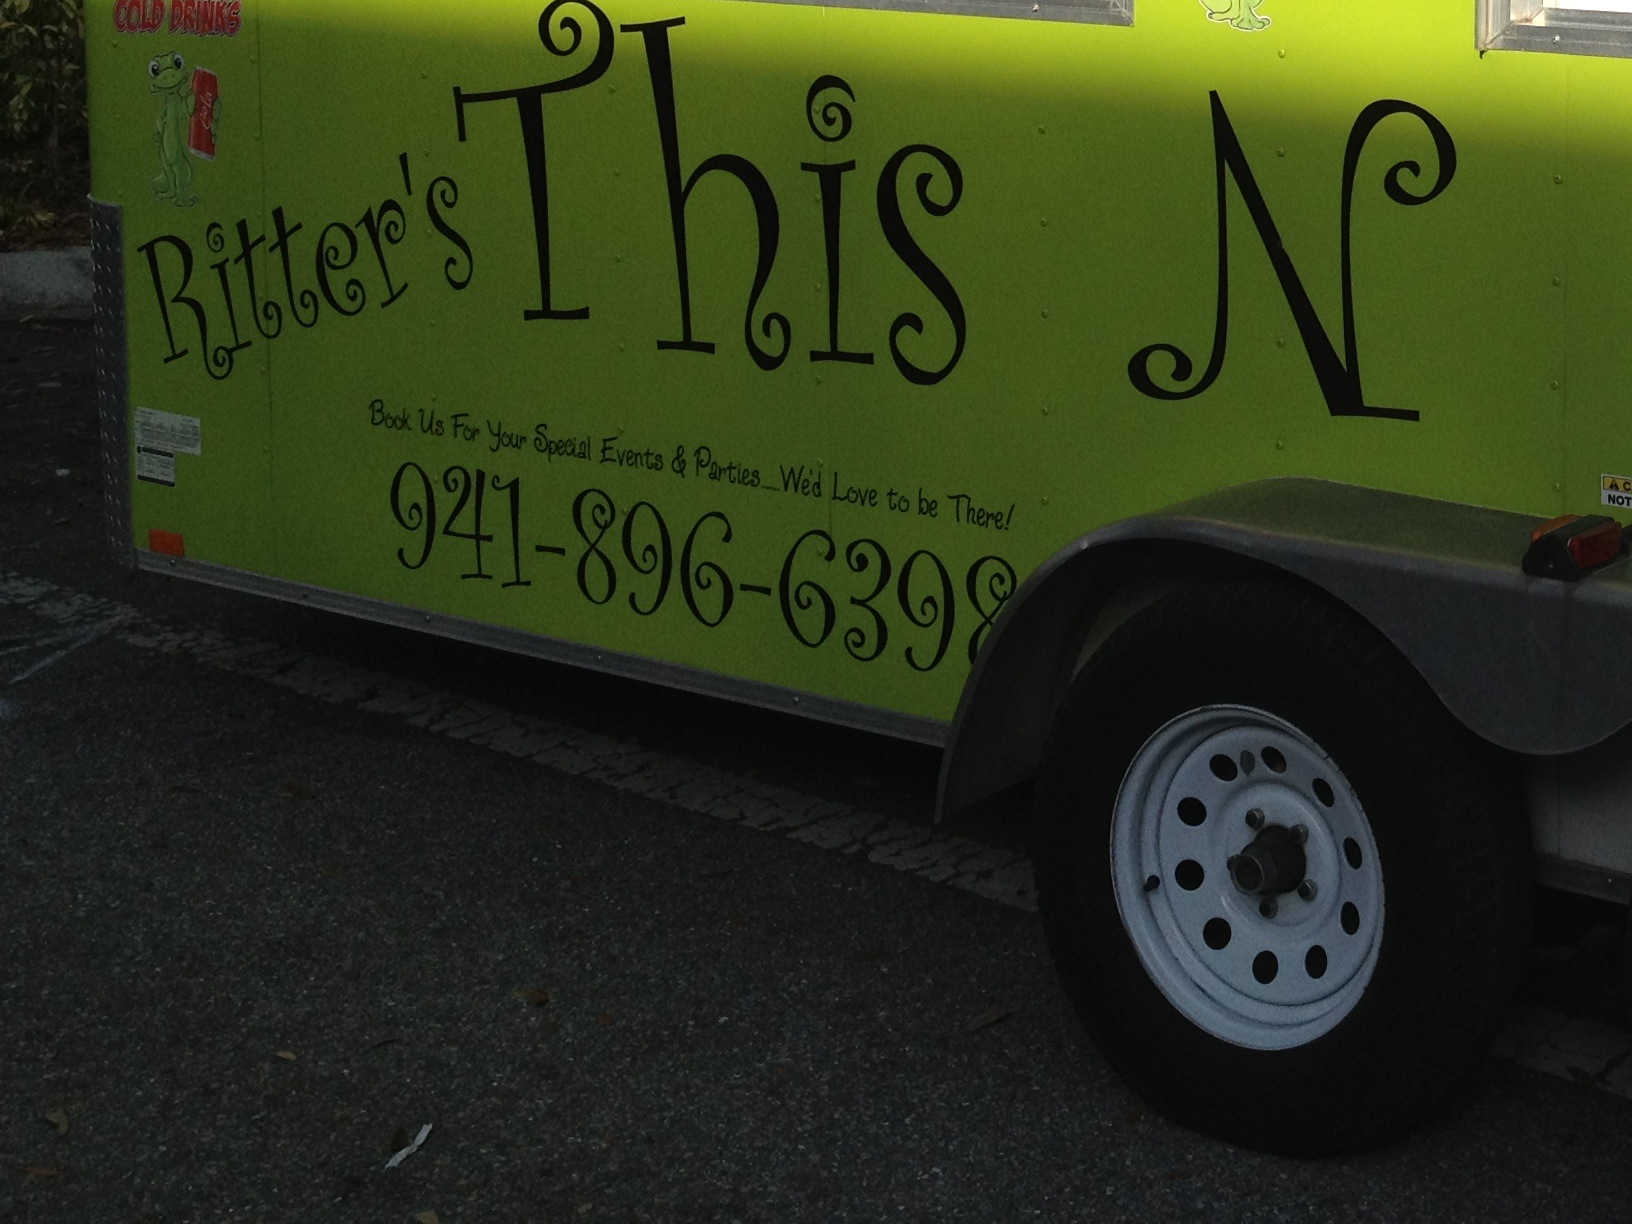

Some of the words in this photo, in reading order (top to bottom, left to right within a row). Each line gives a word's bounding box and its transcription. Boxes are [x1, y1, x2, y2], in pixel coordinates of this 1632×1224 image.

[137, 152, 474, 380] Ritter's
[1126, 88, 1457, 423] N
[369, 398, 412, 431] Book
[418, 407, 445, 437] Us
[450, 412, 481, 442] For
[486, 419, 527, 453] Your
[533, 423, 592, 463] Special
[600, 436, 665, 472] Events
[671, 445, 687, 478] &
[832, 471, 878, 508] Love
[887, 487, 910, 513] to
[917, 487, 938, 518] be
[946, 493, 1016, 531] There!
[1607, 493, 1632, 507] NOT
[389, 460, 1018, 673] 941-896-6398
